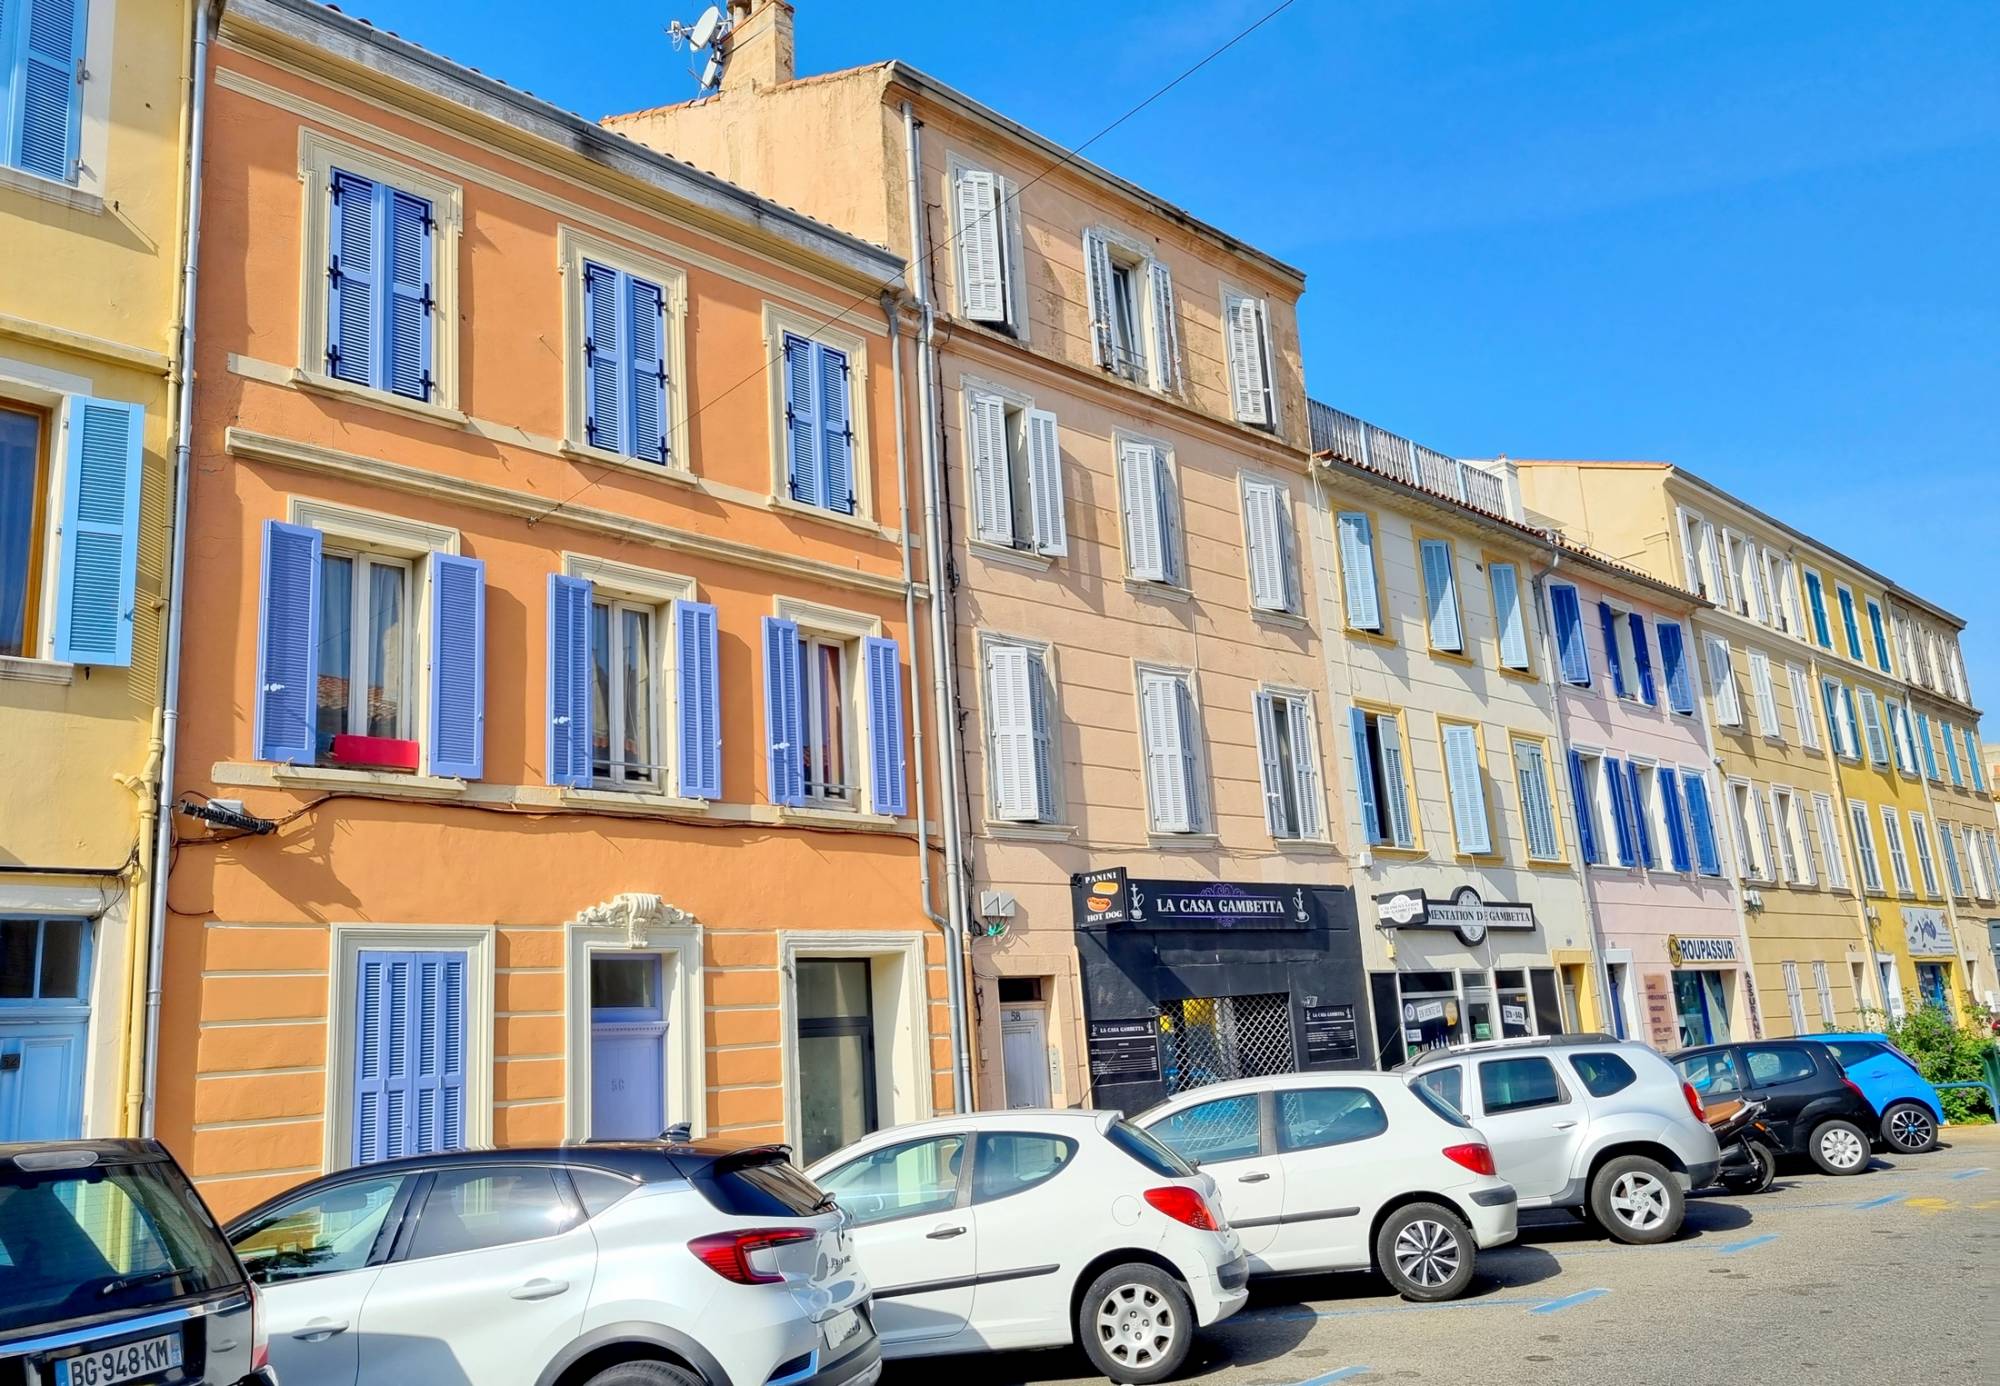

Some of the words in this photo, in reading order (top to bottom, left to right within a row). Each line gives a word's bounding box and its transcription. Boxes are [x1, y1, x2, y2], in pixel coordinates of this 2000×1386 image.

[1085, 872, 1117, 884] PANINI
[1156, 899, 1176, 912] LA
[1180, 899, 1215, 913] CASA
[1218, 900, 1285, 913] GAMBETTA
[1087, 914, 1104, 922] HOT
[1105, 910, 1123, 919] DOG
[1489, 912, 1531, 922] GAMBETTA
[71, 1340, 169, 1386] BG-948-KM
